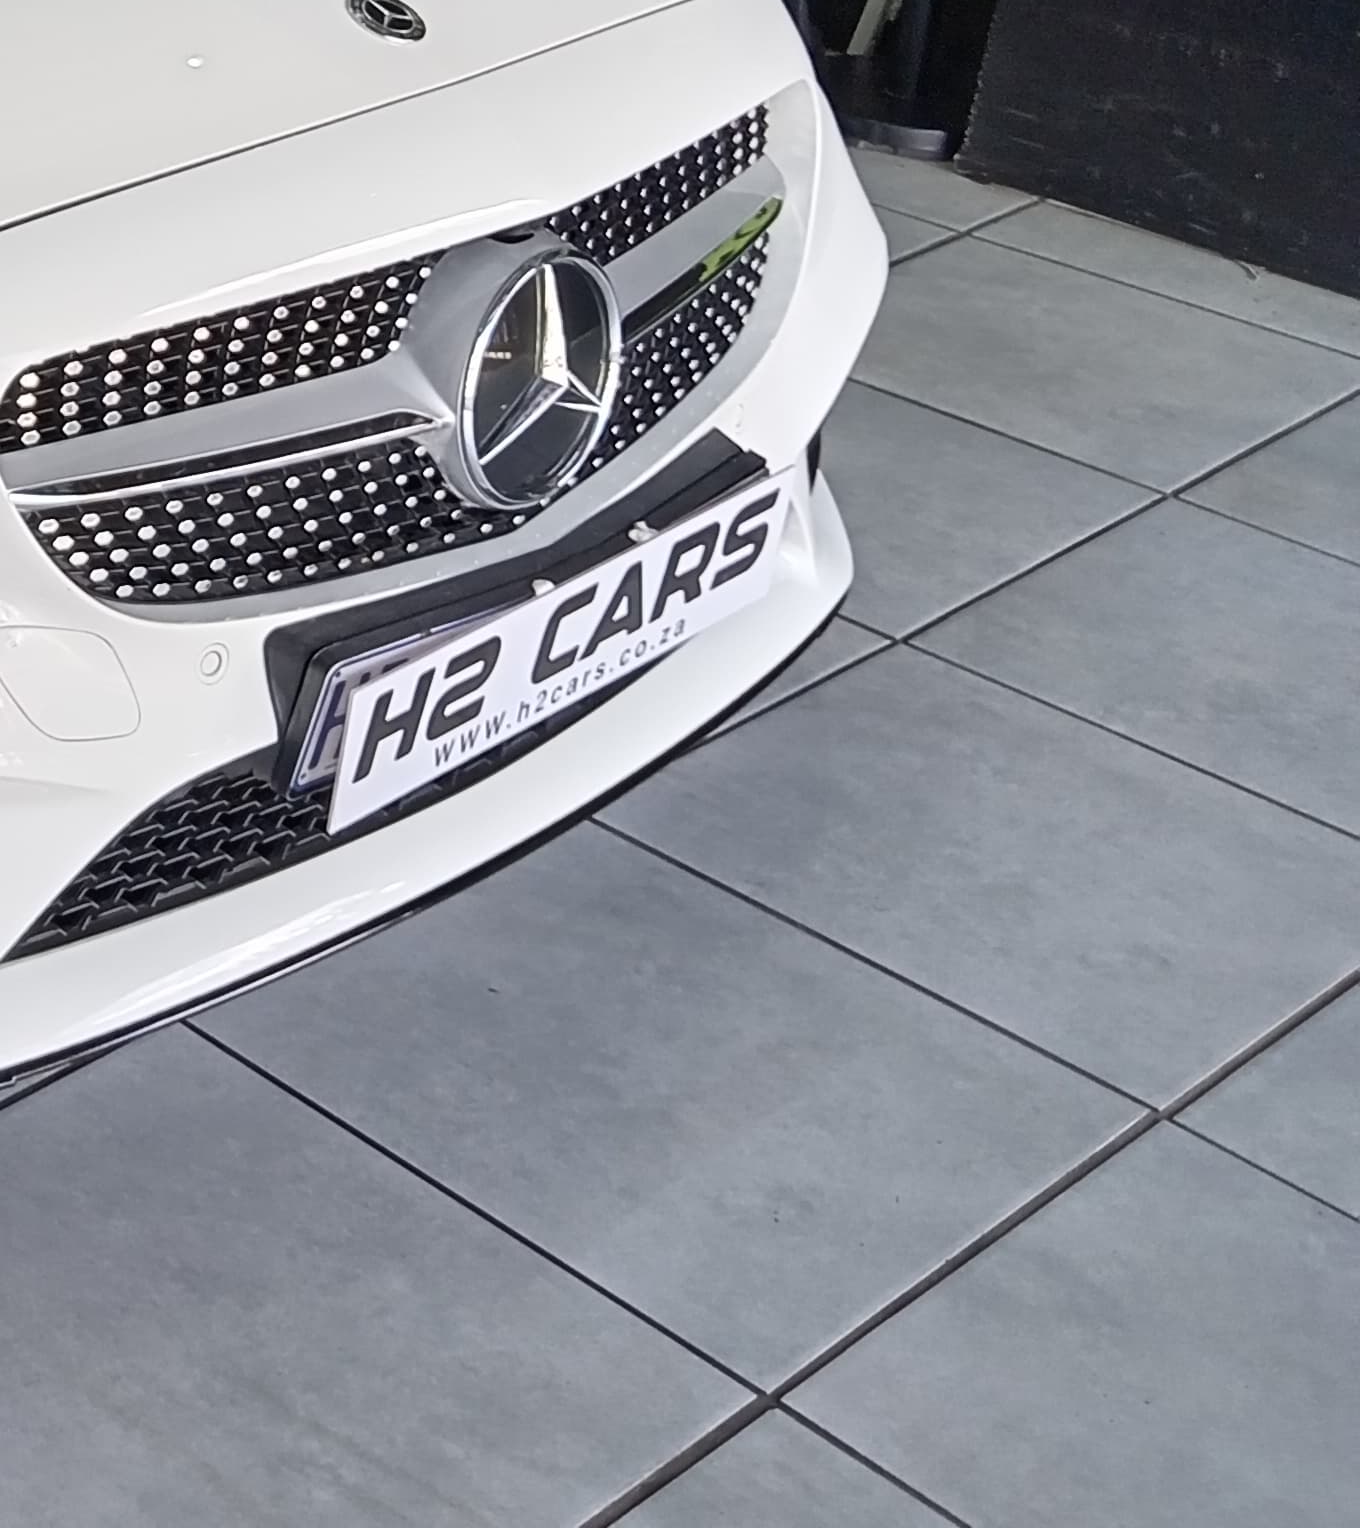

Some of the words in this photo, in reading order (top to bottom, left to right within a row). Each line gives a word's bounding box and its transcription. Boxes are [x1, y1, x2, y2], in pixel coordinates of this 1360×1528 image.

[351, 635, 502, 784] H2
[530, 487, 781, 685] CARS
[433, 618, 685, 767] www.h2cars.co.za
